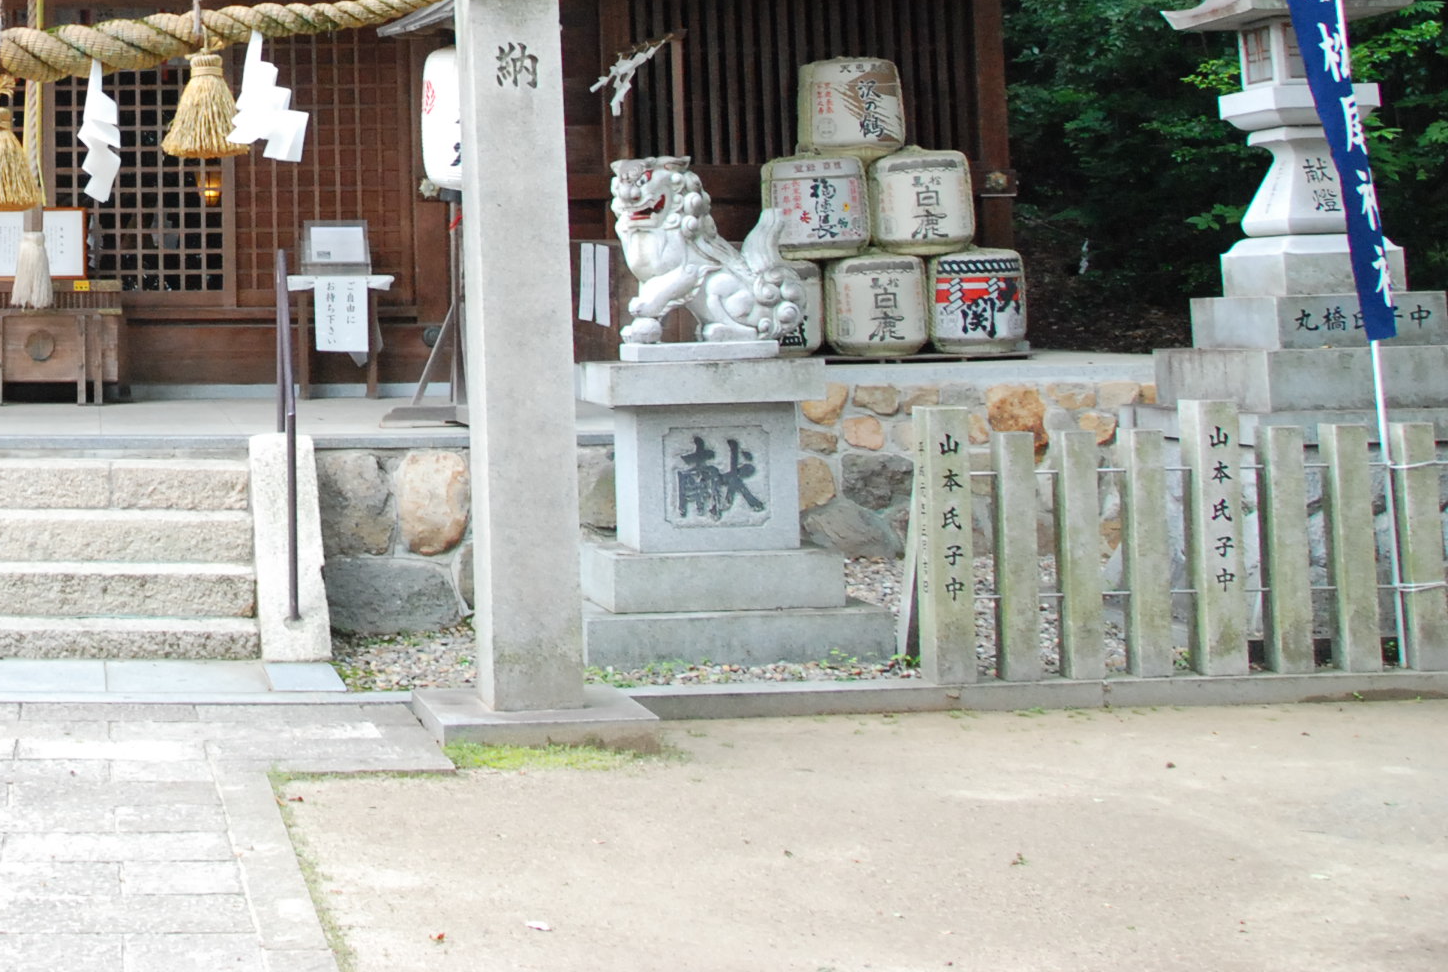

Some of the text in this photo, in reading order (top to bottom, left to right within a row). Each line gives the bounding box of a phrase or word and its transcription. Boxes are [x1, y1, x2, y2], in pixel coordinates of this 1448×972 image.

[495, 41, 539, 89] 納
[856, 80, 885, 138] 沢の鶴
[911, 185, 949, 239] 白鹿
[869, 287, 905, 342] 白鹿
[939, 433, 965, 602] 山本氏子中
[1210, 426, 1236, 593] 山本氏子中
